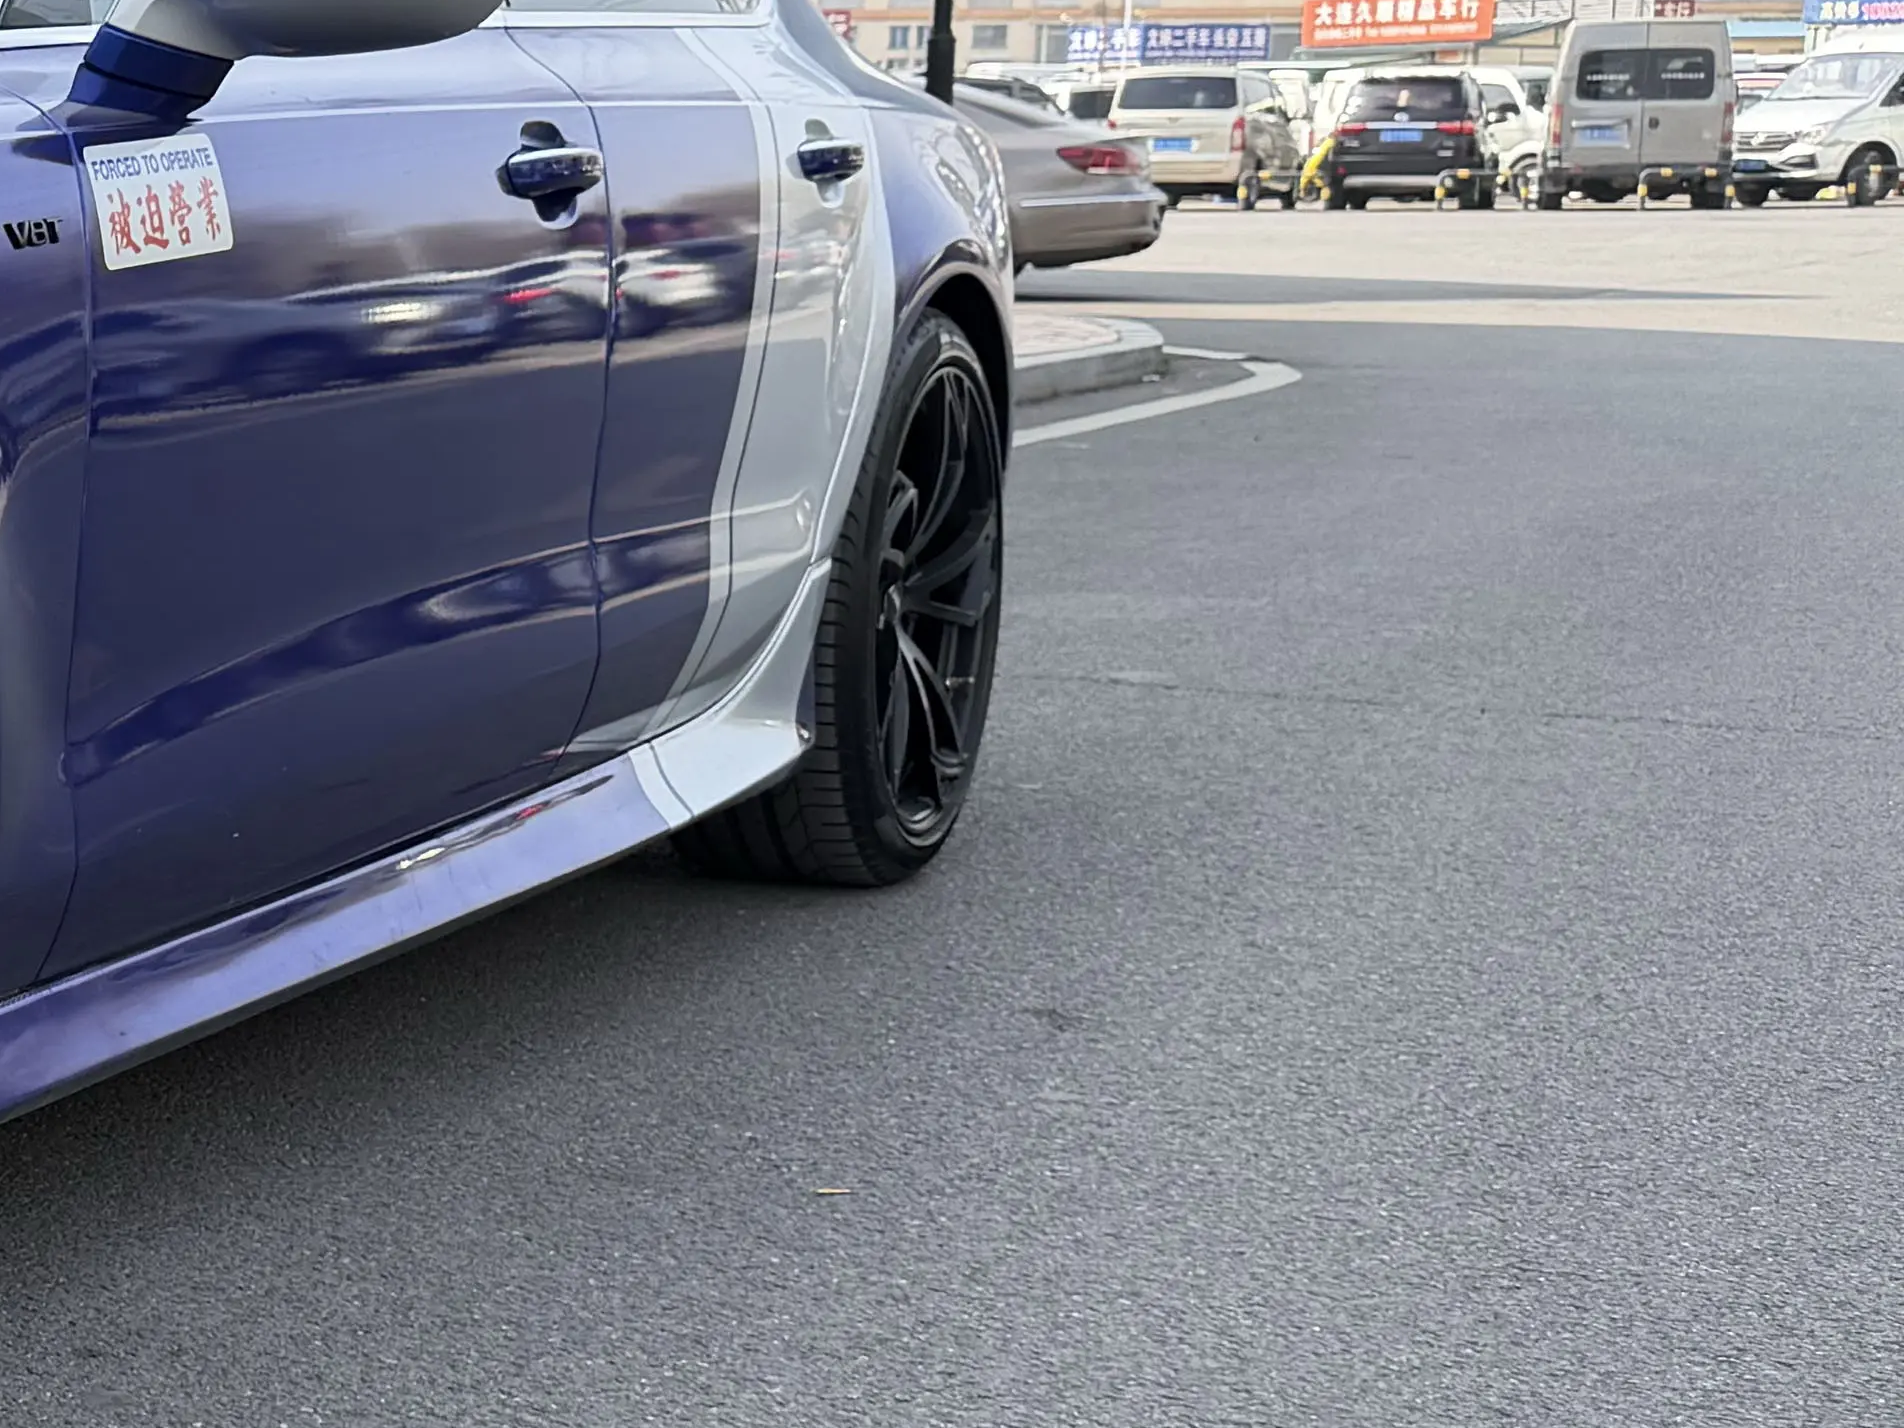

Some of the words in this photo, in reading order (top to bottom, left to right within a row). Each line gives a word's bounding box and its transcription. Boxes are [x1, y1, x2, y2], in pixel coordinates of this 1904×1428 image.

[92, 154, 141, 181] FORCED
[141, 152, 160, 174] TO
[161, 147, 213, 171] OPERATE
[3, 217, 63, 250] V8T
